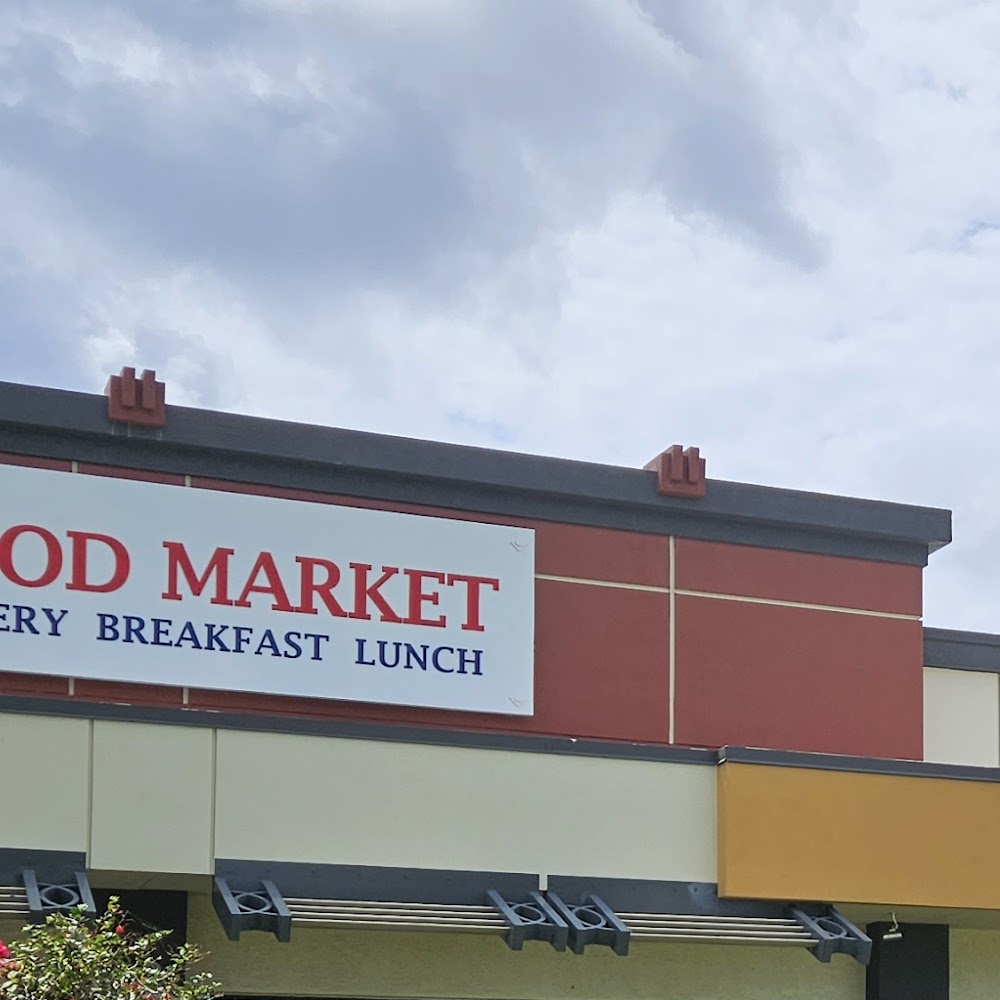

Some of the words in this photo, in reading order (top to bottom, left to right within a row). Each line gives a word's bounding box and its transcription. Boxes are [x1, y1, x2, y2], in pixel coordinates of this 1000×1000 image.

[161, 540, 500, 633] MARKET
[96, 612, 329, 660] BREAKFAST
[355, 638, 483, 676] LUNCH
